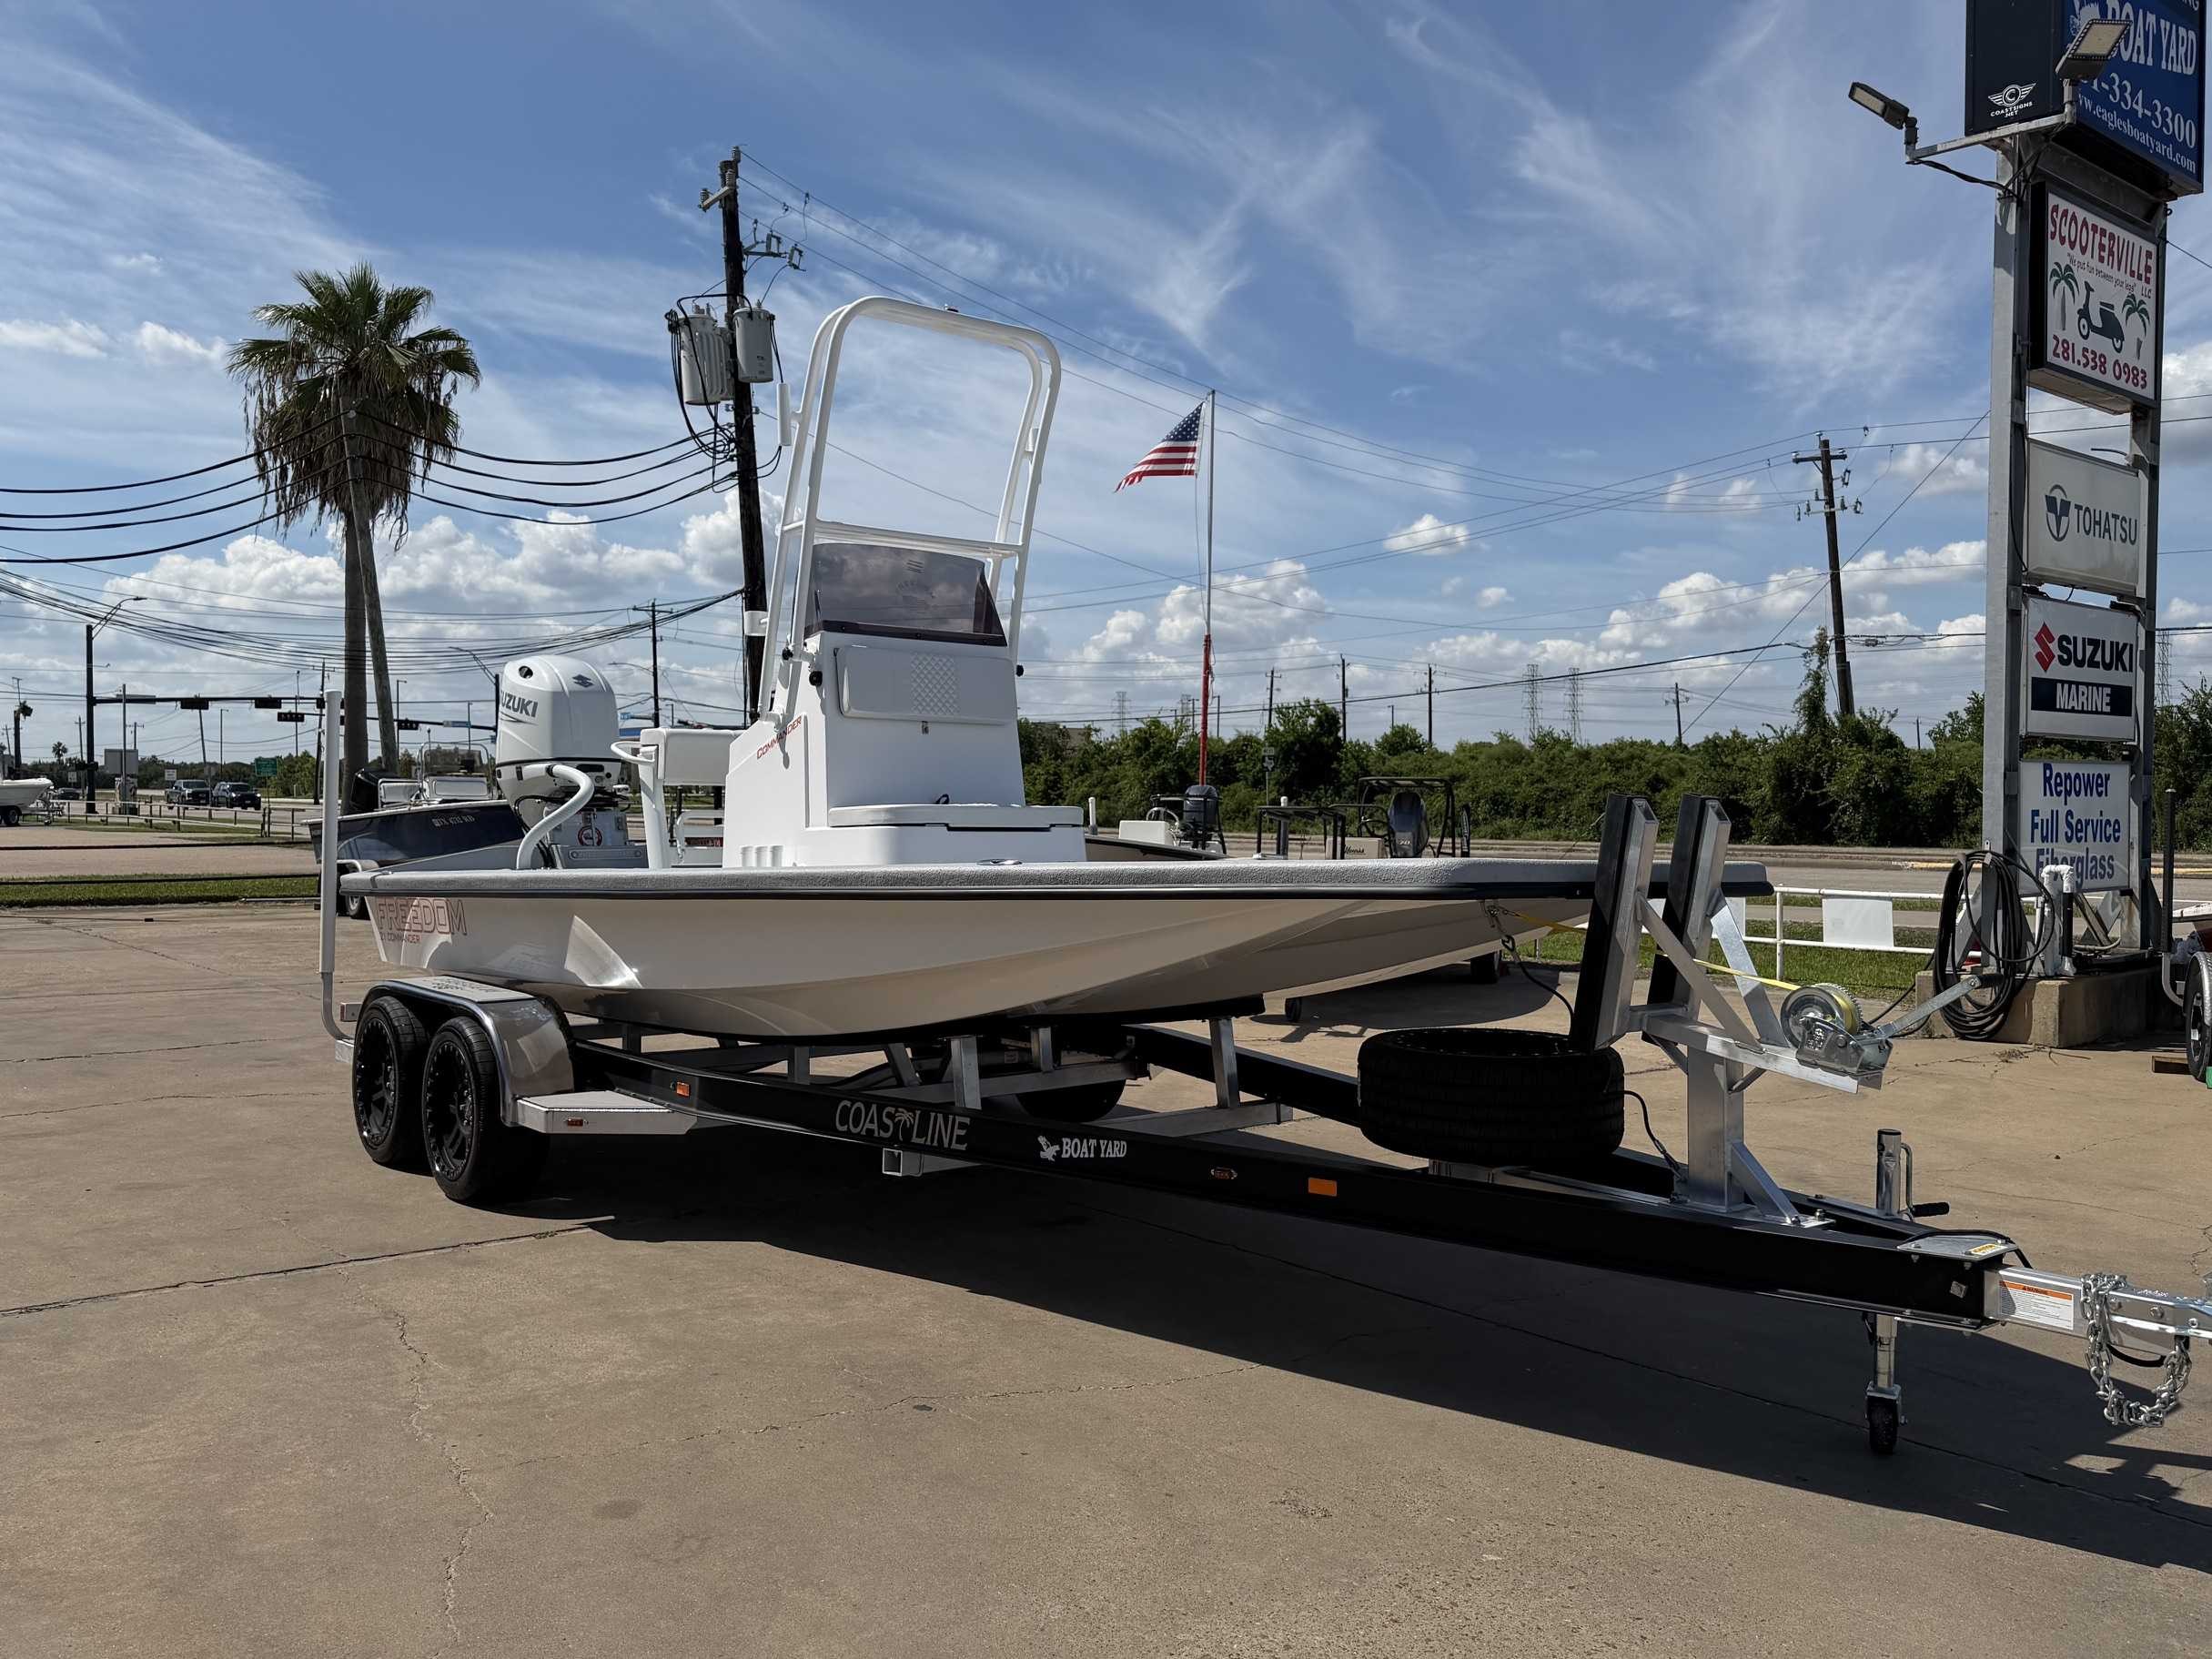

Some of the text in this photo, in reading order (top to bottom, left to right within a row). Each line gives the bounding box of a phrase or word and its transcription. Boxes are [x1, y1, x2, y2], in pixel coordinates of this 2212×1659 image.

[2159, 18, 2197, 76] YARD
[2080, 72, 2197, 149] 1-334-3300
[2078, 93, 2197, 174] ww.eaglesboatyard.com
[2049, 203, 2153, 285] SCOOTERVILLE
[2141, 285, 2152, 299] LLC
[2052, 334, 2147, 389] 281.538 0983
[2074, 503, 2137, 546] TOHATSU
[2057, 633, 2134, 673] SUZUKI
[500, 689, 539, 718] UZUKI
[2055, 683, 2111, 713] MARINE
[756, 714, 803, 760] COMMANDER
[2043, 763, 2111, 805] Repower
[2030, 809, 2122, 844] Full Service
[375, 896, 468, 936] FREEDOM
[1061, 1138, 1128, 1159] BOAT YARD
